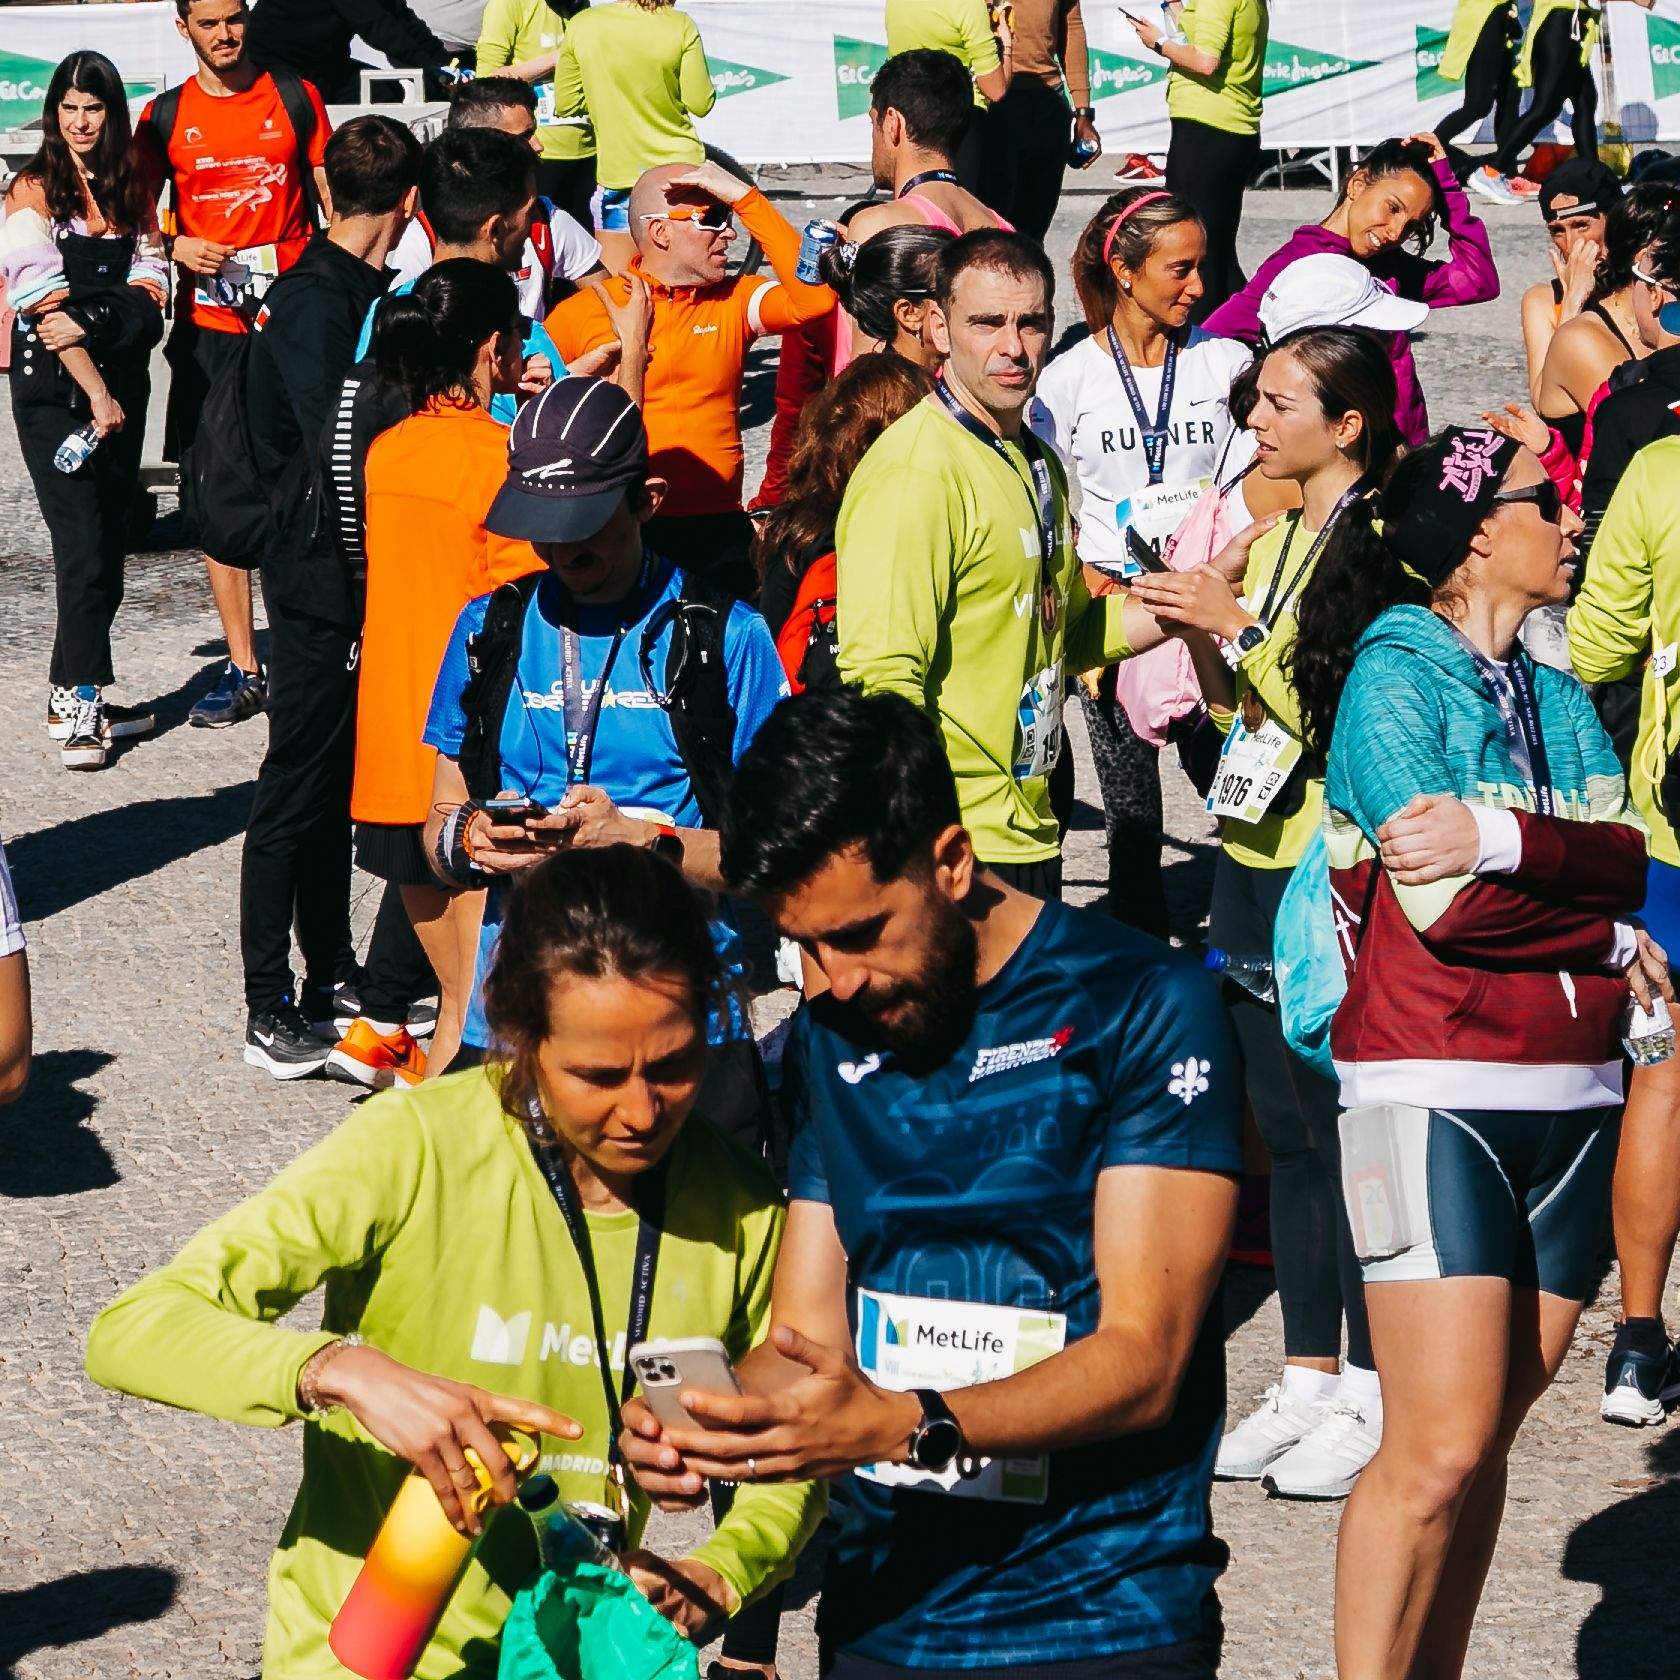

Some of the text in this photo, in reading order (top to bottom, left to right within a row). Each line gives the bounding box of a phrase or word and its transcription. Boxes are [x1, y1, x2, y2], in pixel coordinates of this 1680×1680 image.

[1651, 44, 1670, 64] El
[837, 65, 857, 84] El
[1093, 58, 1153, 89] Inglés
[1101, 421, 1215, 454] RUNER
[1157, 490, 1199, 505] MetLife
[576, 733, 588, 768] MetLife
[1218, 773, 1253, 807] 1976
[634, 1254, 652, 1338] MADRID ACTIVA
[539, 1322, 627, 1373] MetL
[917, 1324, 1004, 1354] MetLife
[540, 1454, 604, 1475] MADRID
